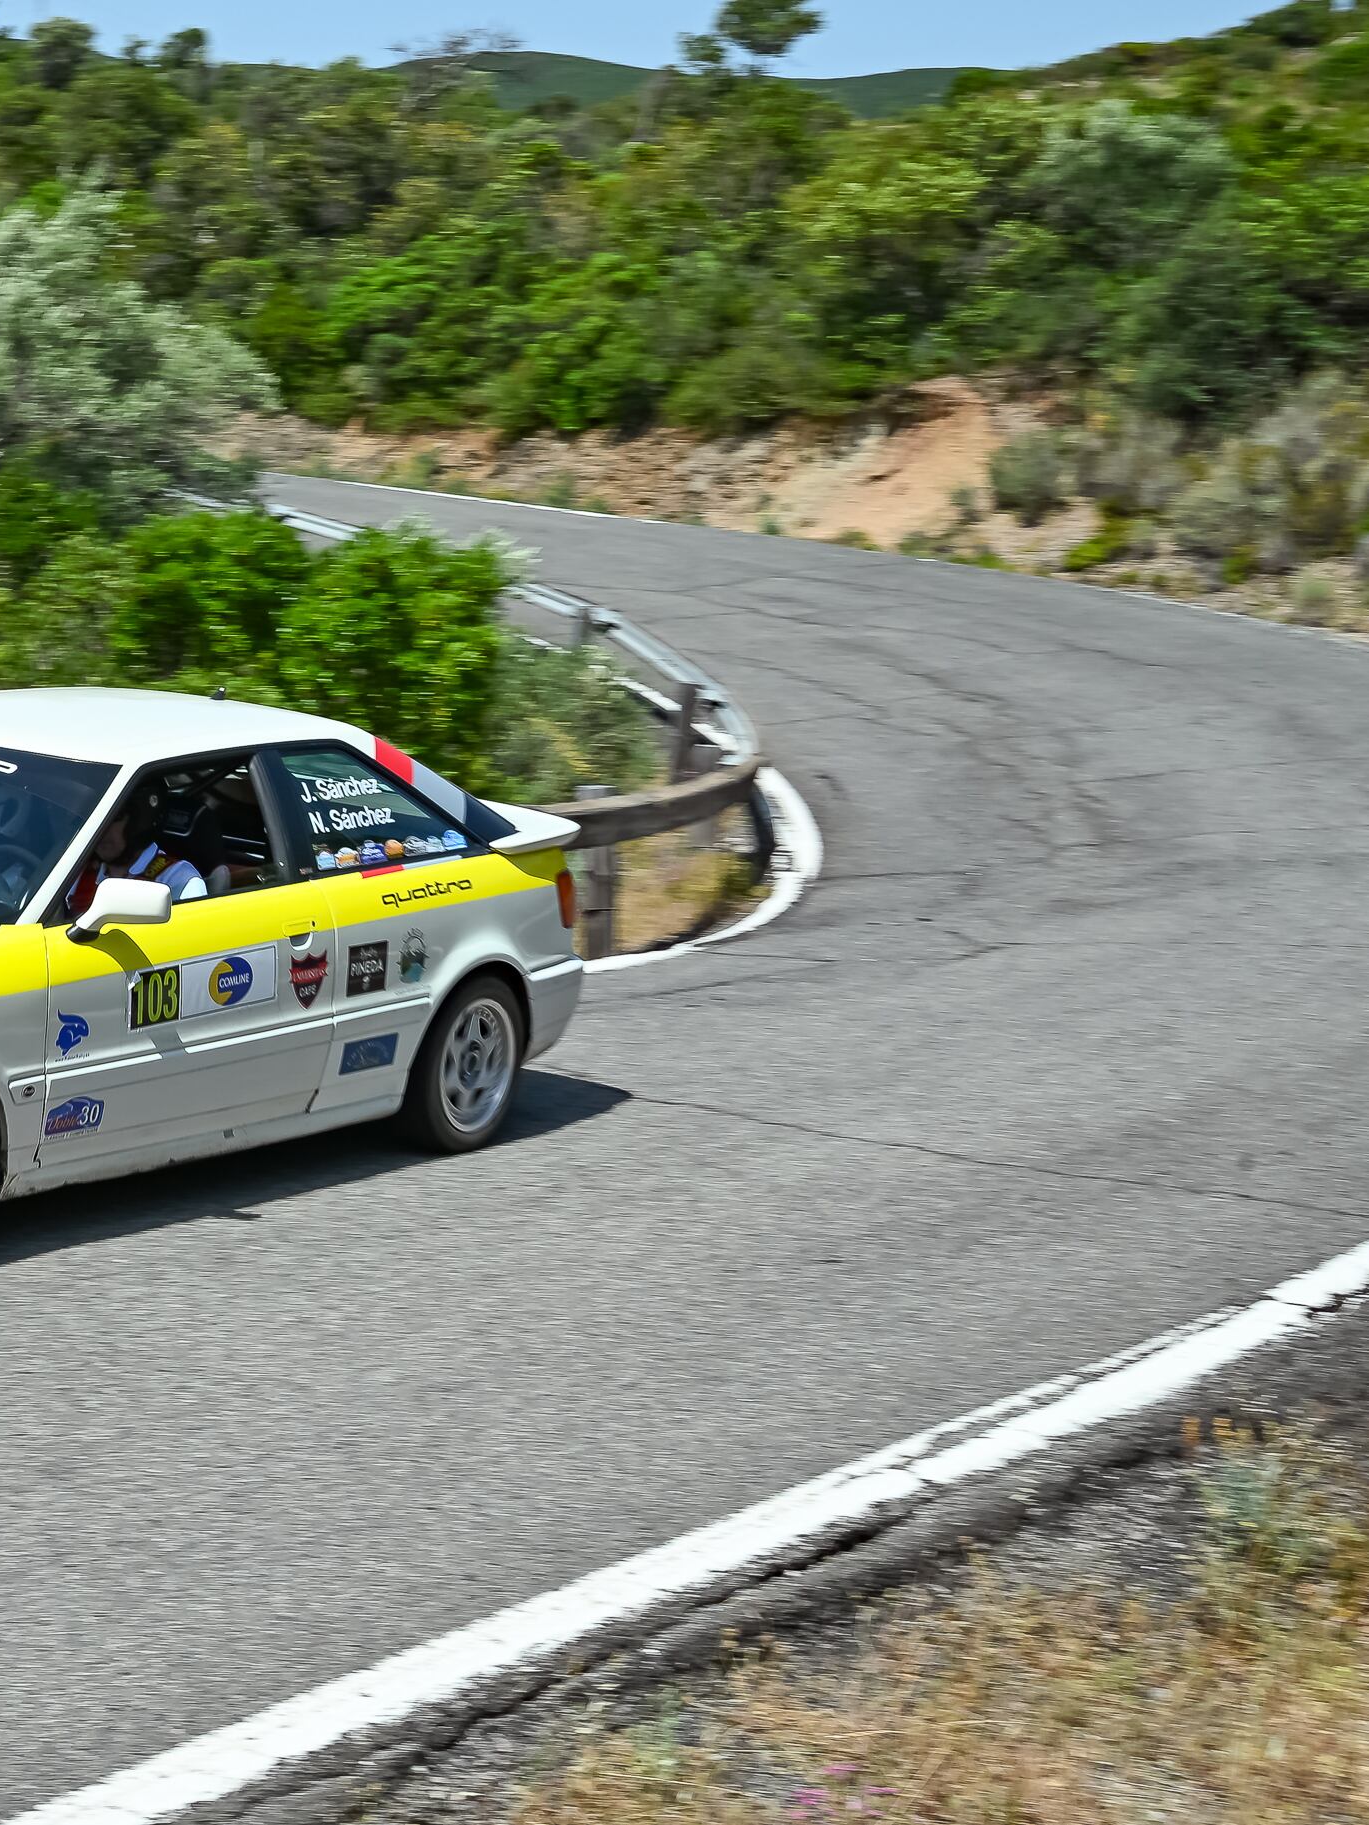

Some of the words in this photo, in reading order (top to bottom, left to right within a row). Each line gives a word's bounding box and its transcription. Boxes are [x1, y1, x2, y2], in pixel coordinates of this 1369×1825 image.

[300, 781, 318, 804] J.
[316, 776, 383, 801] Sánchez
[308, 811, 330, 834] N.
[331, 805, 395, 831] Sánchez
[381, 879, 472, 908] quattro
[133, 969, 178, 1025] 103
[80, 1103, 100, 1125] 30
